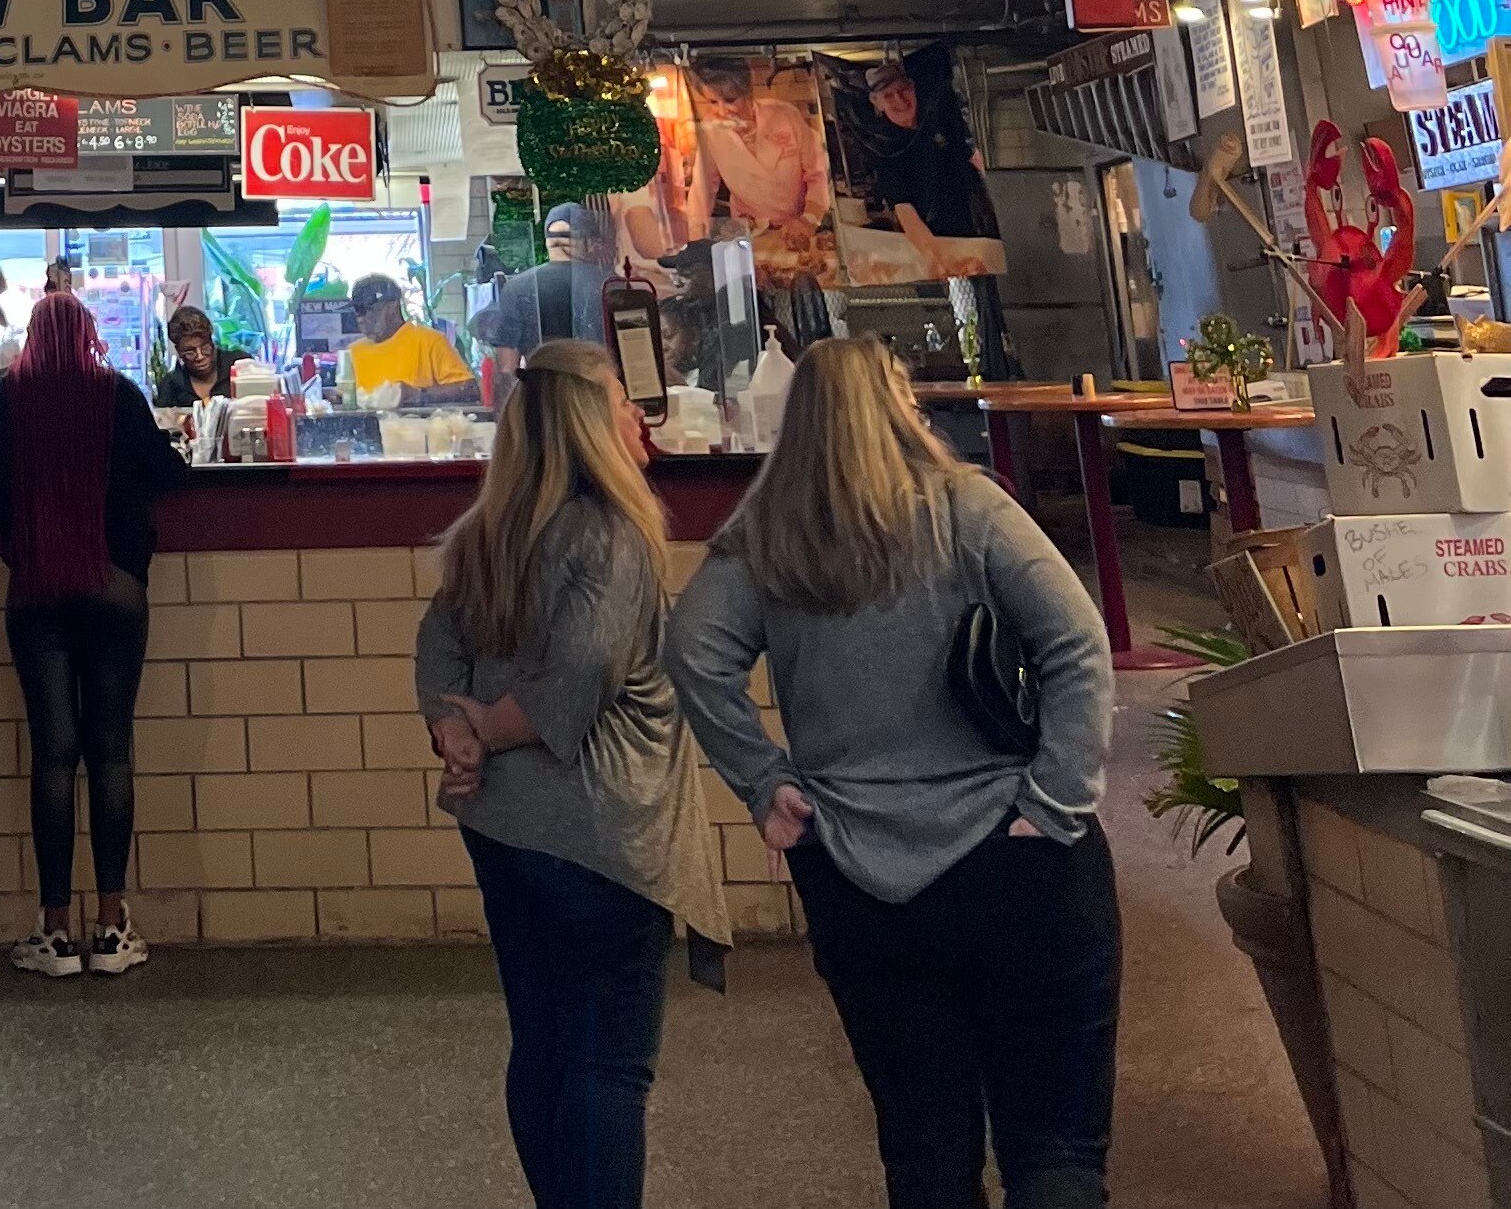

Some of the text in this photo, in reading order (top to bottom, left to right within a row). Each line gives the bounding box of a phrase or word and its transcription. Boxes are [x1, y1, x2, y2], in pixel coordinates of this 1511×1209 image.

[184, 28, 325, 62] BEER
[15, 121, 40, 133] EAT
[287, 125, 311, 136] Enjoy
[250, 123, 368, 184] Coke
[1436, 538, 1505, 557] STEAMED
[1363, 546, 1387, 571] OF
[1444, 560, 1508, 577] CRABS
